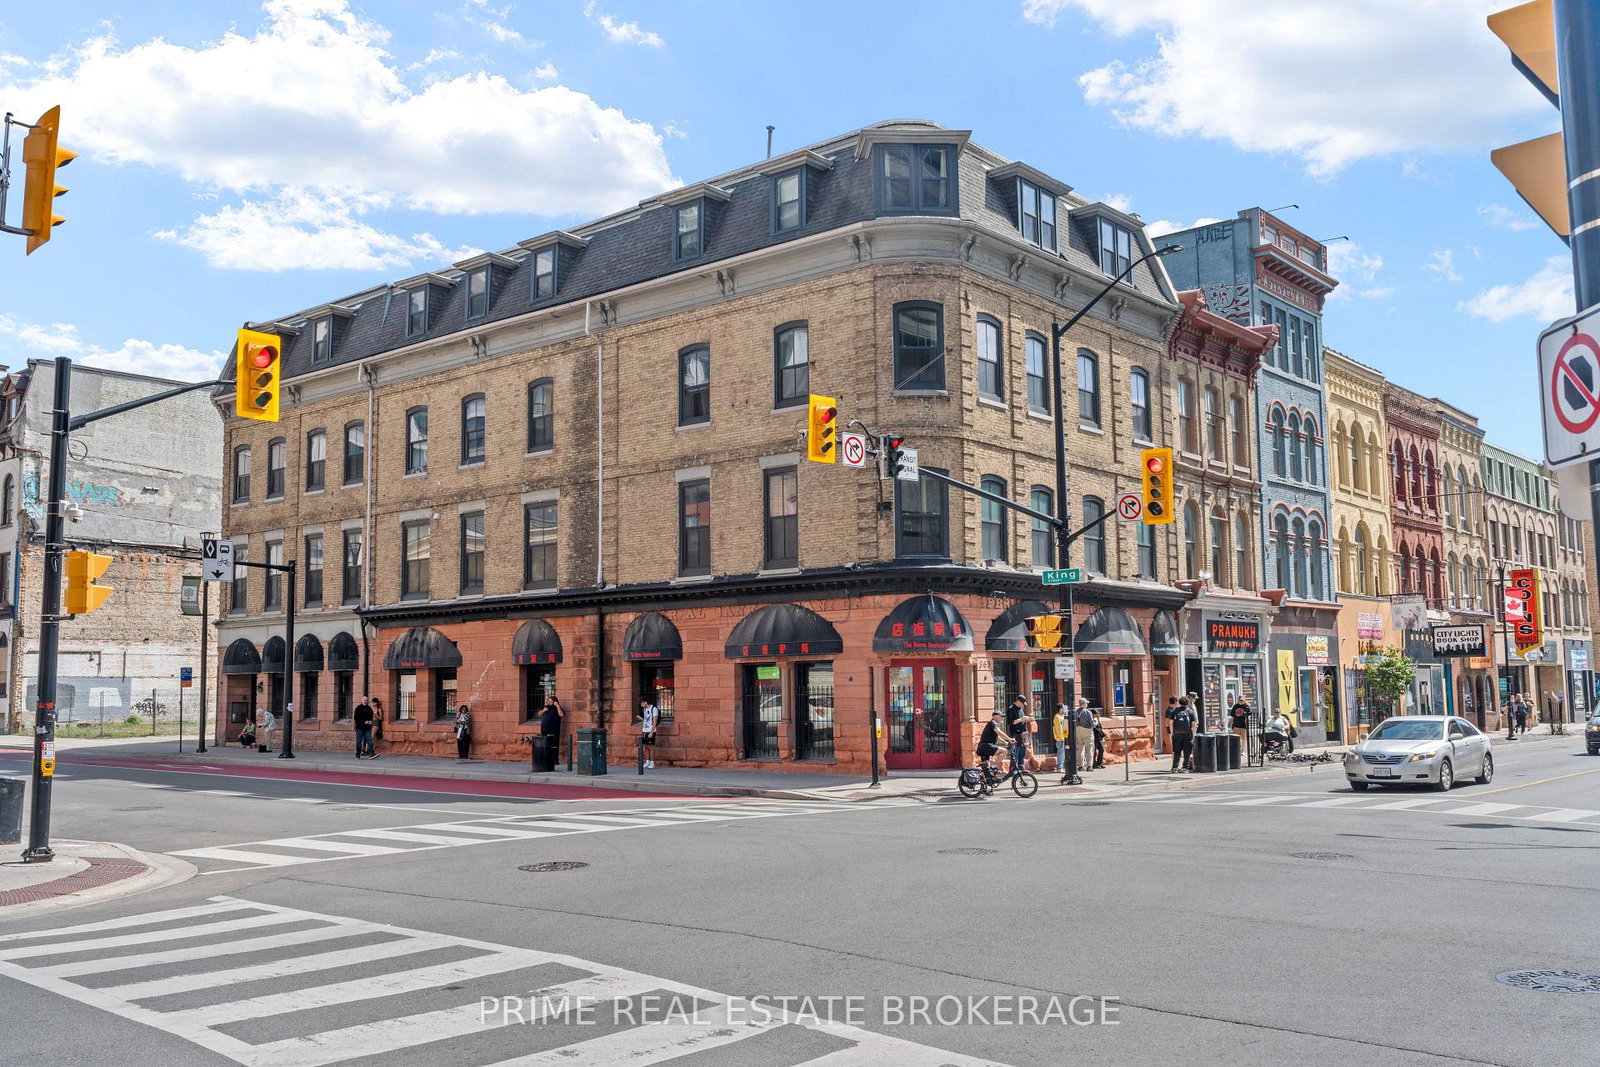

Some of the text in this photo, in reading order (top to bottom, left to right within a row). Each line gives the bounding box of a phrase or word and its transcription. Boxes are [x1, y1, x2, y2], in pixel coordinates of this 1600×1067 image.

[1047, 571, 1076, 580] King
[1517, 578, 1534, 635] COINS
[1212, 624, 1256, 639] PRAMUKH
